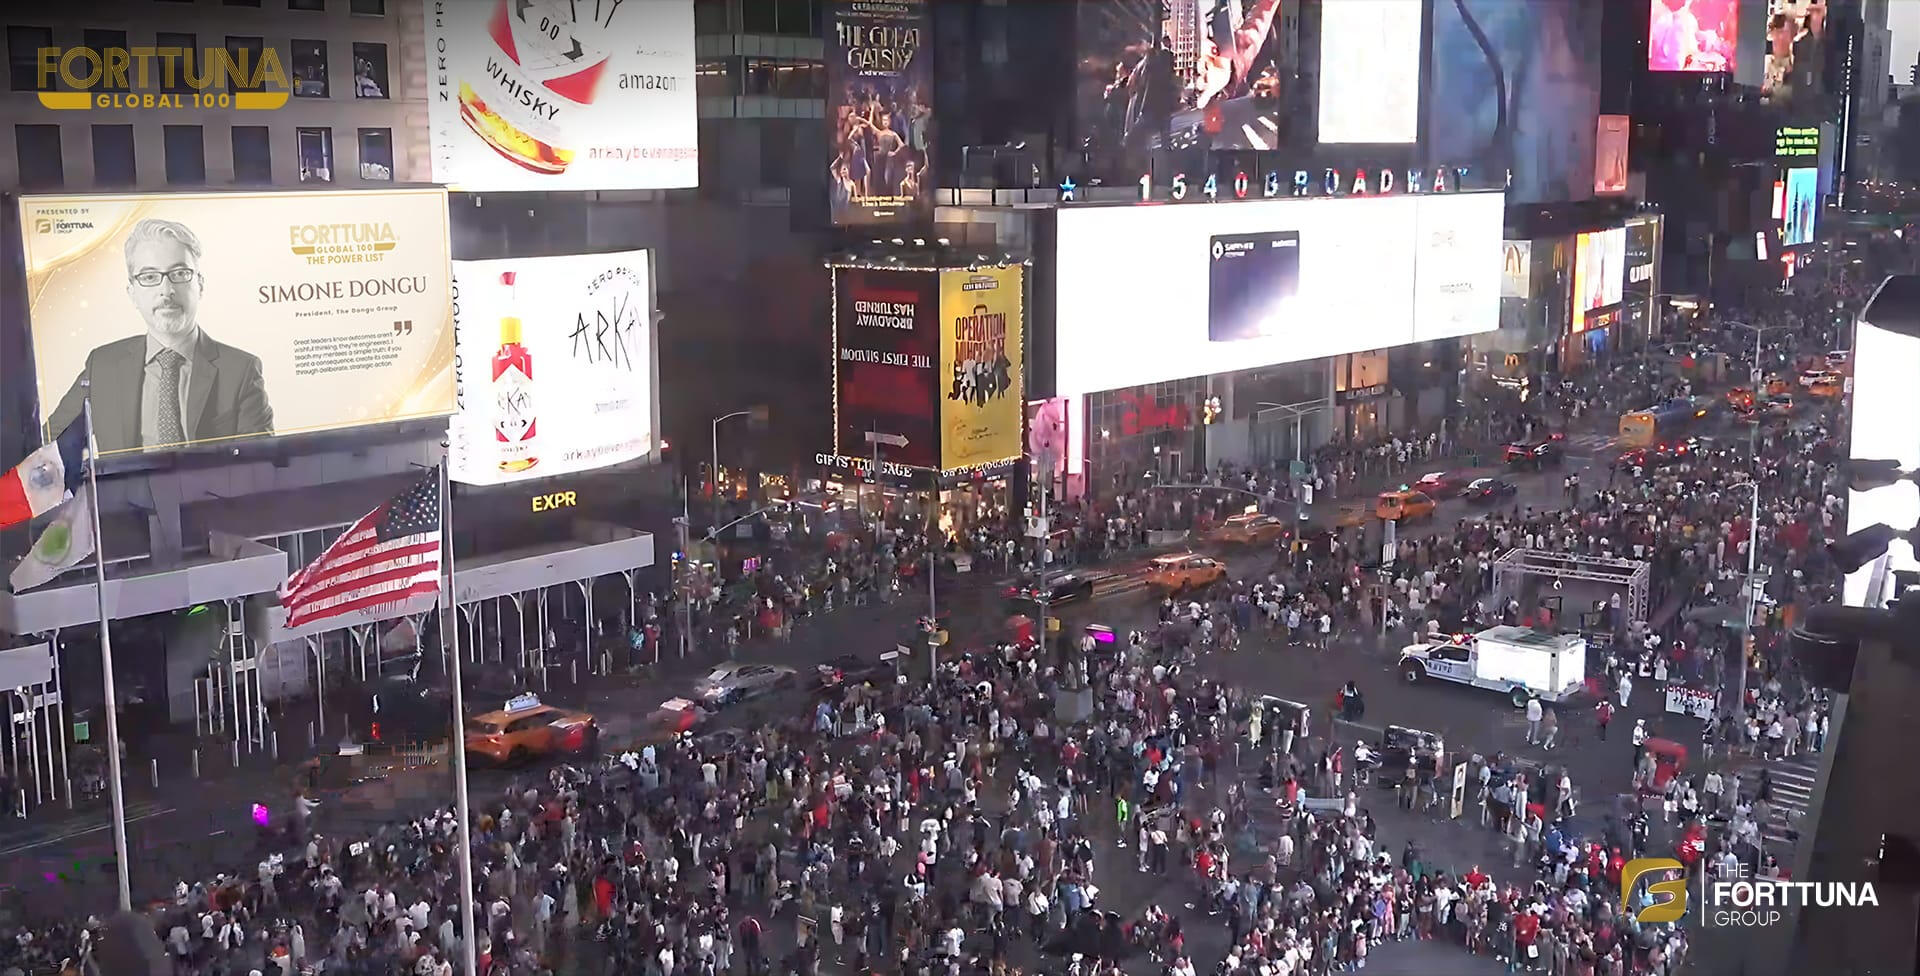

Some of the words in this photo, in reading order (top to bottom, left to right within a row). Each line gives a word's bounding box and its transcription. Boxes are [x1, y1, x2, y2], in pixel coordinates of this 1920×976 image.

[836, 22, 866, 47] THE
[869, 26, 920, 48] GREAT
[847, 47, 913, 70] GATSBY
[436, 37, 449, 102] ZERO
[486, 56, 560, 121] WHISKY
[619, 73, 677, 92] amazon
[56, 222, 94, 230] FORTTUNA
[289, 222, 396, 245] FORTTUNA
[316, 245, 353, 254] GLOBAL
[357, 243, 373, 252] 100
[306, 255, 325, 265] THE
[328, 254, 363, 264] POWER
[365, 252, 385, 262] LIST
[258, 281, 344, 304] SIMONE
[349, 276, 427, 298] DONGU
[295, 308, 333, 318] President,
[351, 306, 374, 315] Dongu
[855, 301, 892, 315] TURNED
[893, 303, 915, 317] HAS
[856, 314, 913, 330] BROADWAY
[955, 311, 1006, 341] OPERATION
[881, 351, 909, 366] FIRST
[531, 490, 578, 513] EXPR
